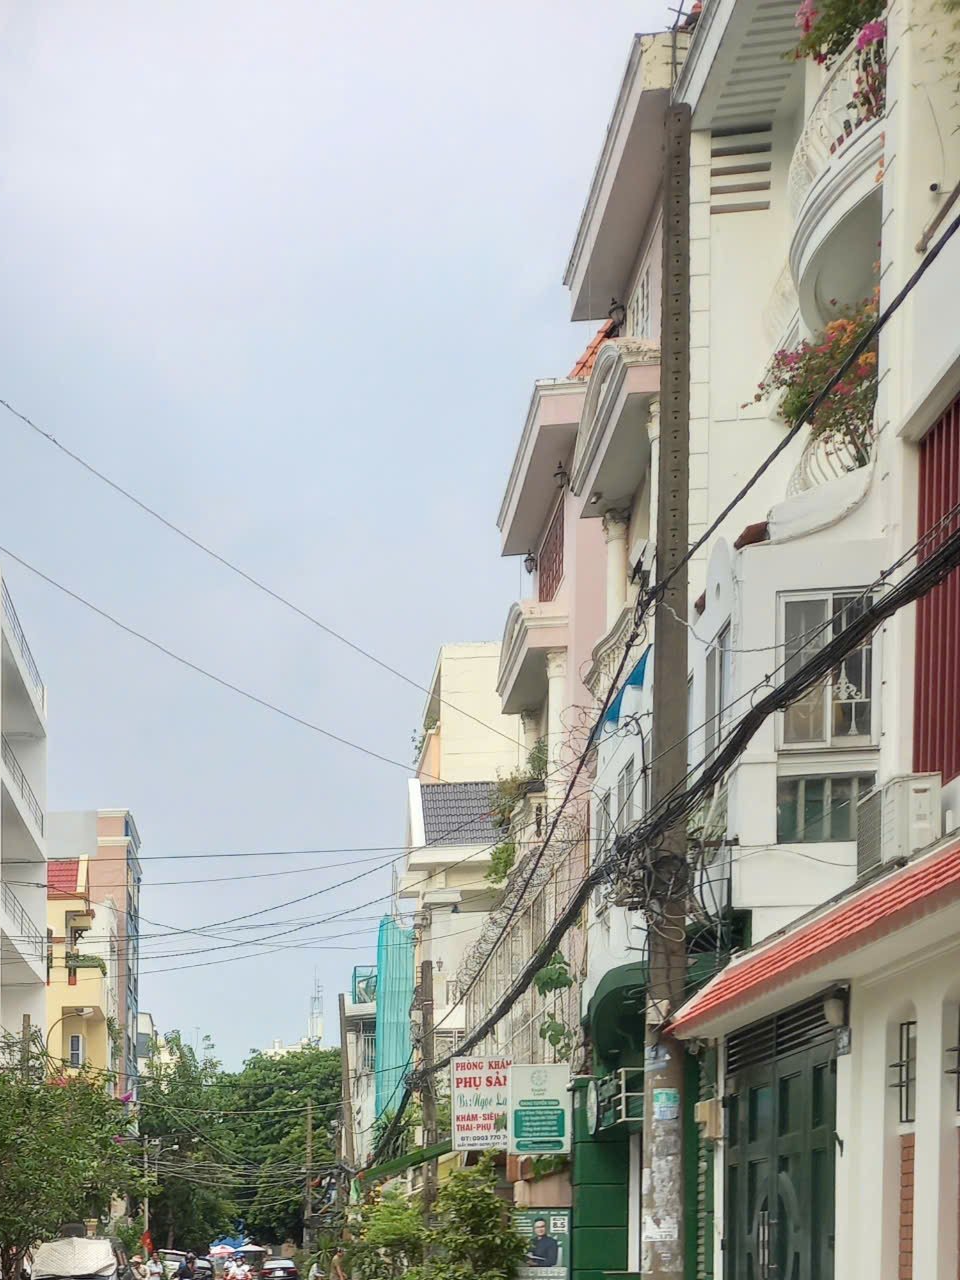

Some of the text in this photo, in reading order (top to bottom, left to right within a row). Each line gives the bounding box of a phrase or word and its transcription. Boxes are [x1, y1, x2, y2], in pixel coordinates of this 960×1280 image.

[456, 1060, 483, 1070] PHÒNG
[456, 1077, 482, 1090] PHỤ
[552, 1221, 566, 1229] 8.5
